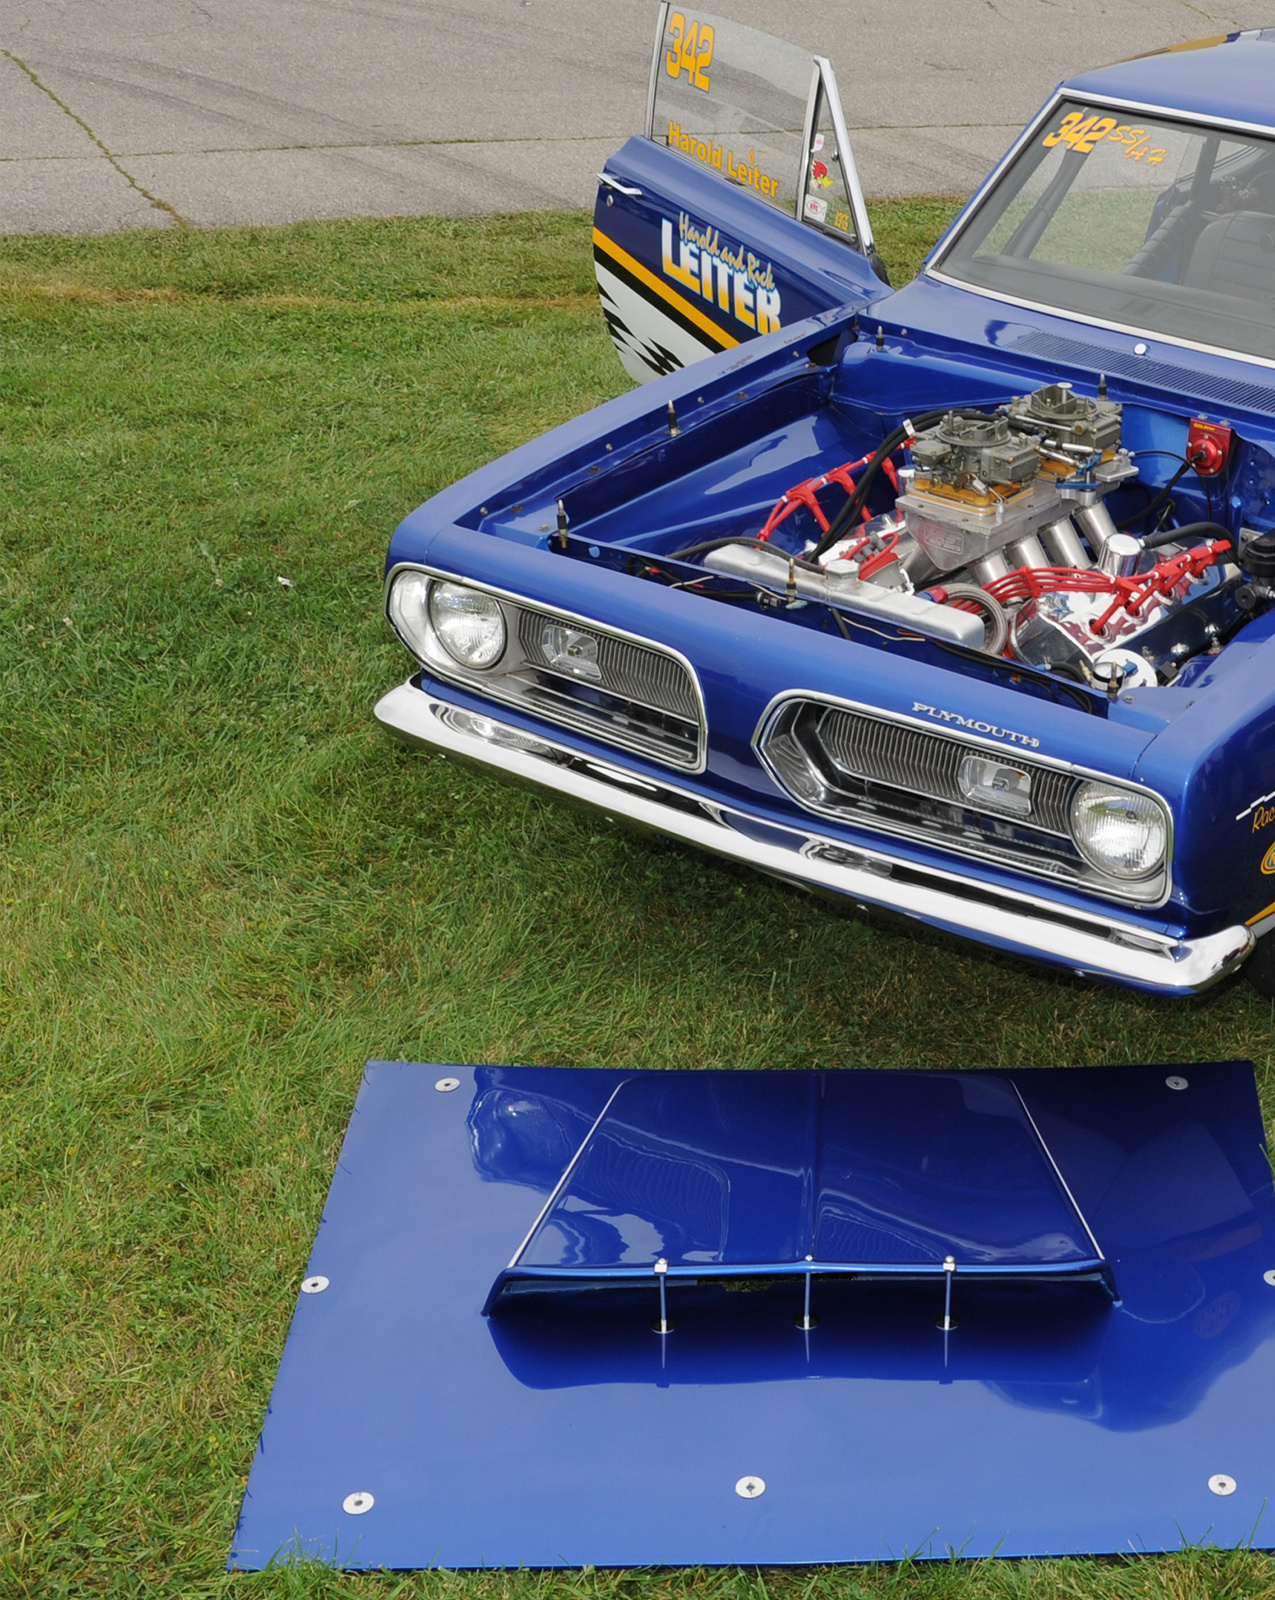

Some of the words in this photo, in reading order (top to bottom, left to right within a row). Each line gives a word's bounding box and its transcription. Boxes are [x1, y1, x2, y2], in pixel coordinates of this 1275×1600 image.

[666, 12, 715, 92] 342
[668, 120, 722, 170] Harold
[727, 151, 779, 198] Leiter
[1042, 111, 1118, 154] 342
[661, 217, 782, 336] LEITER
[679, 211, 720, 257] Harold
[718, 244, 746, 272] and
[746, 250, 777, 291] Rick
[911, 701, 1041, 748] PLYMOUTH
